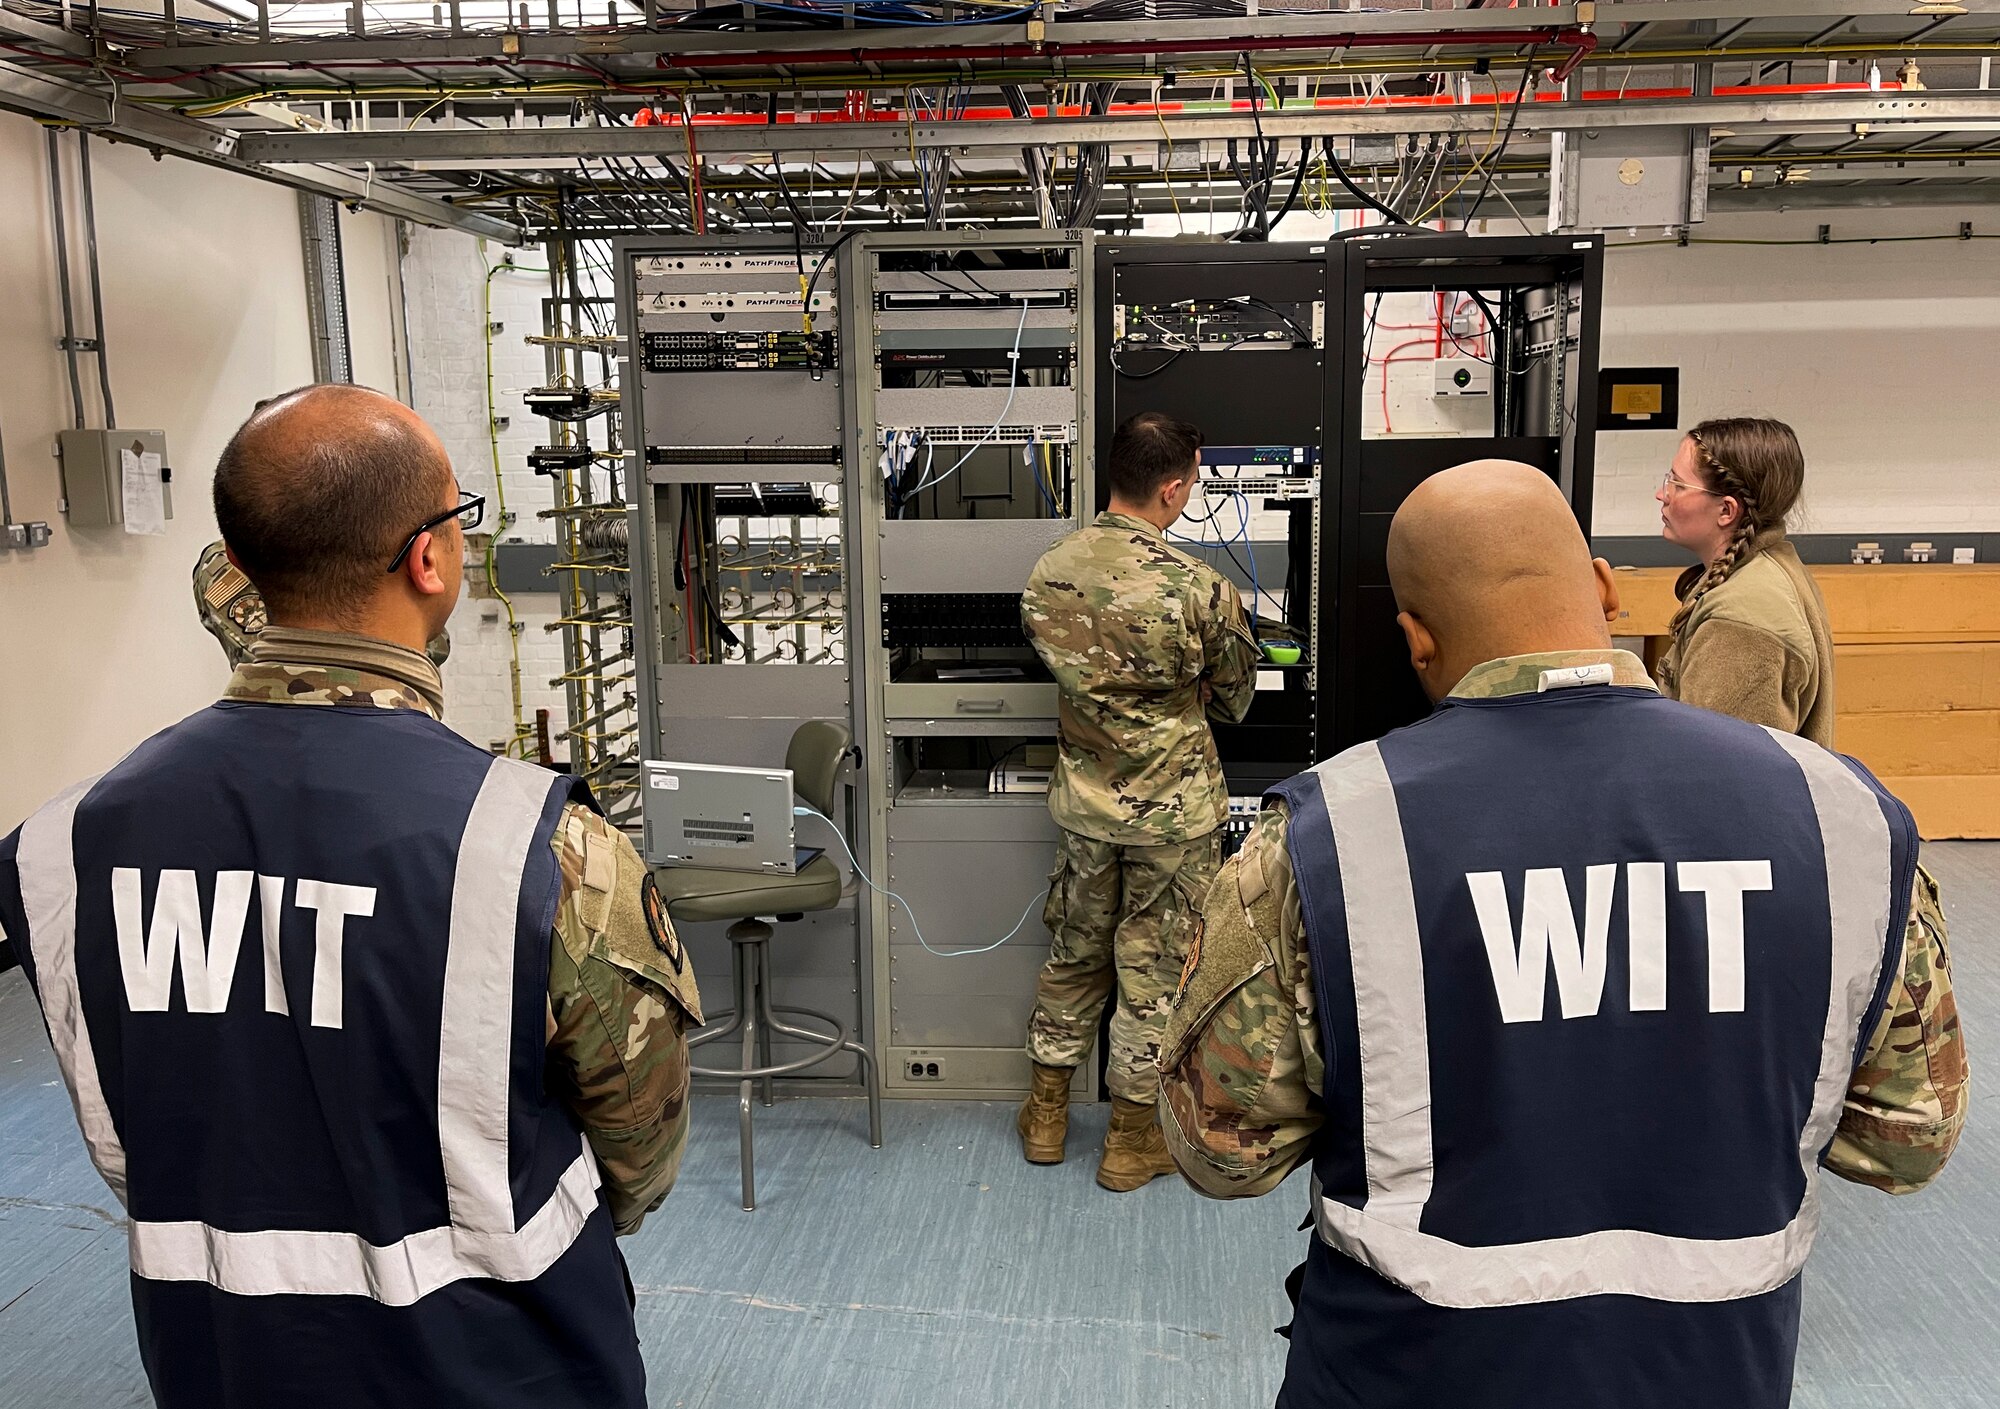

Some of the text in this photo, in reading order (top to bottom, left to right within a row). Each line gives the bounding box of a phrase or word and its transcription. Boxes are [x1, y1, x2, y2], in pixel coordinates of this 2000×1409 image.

[806, 233, 824, 244] 3204
[1065, 229, 1083, 240] 3205
[112, 867, 377, 1029] WIT
[1465, 860, 1773, 1023] WIT
